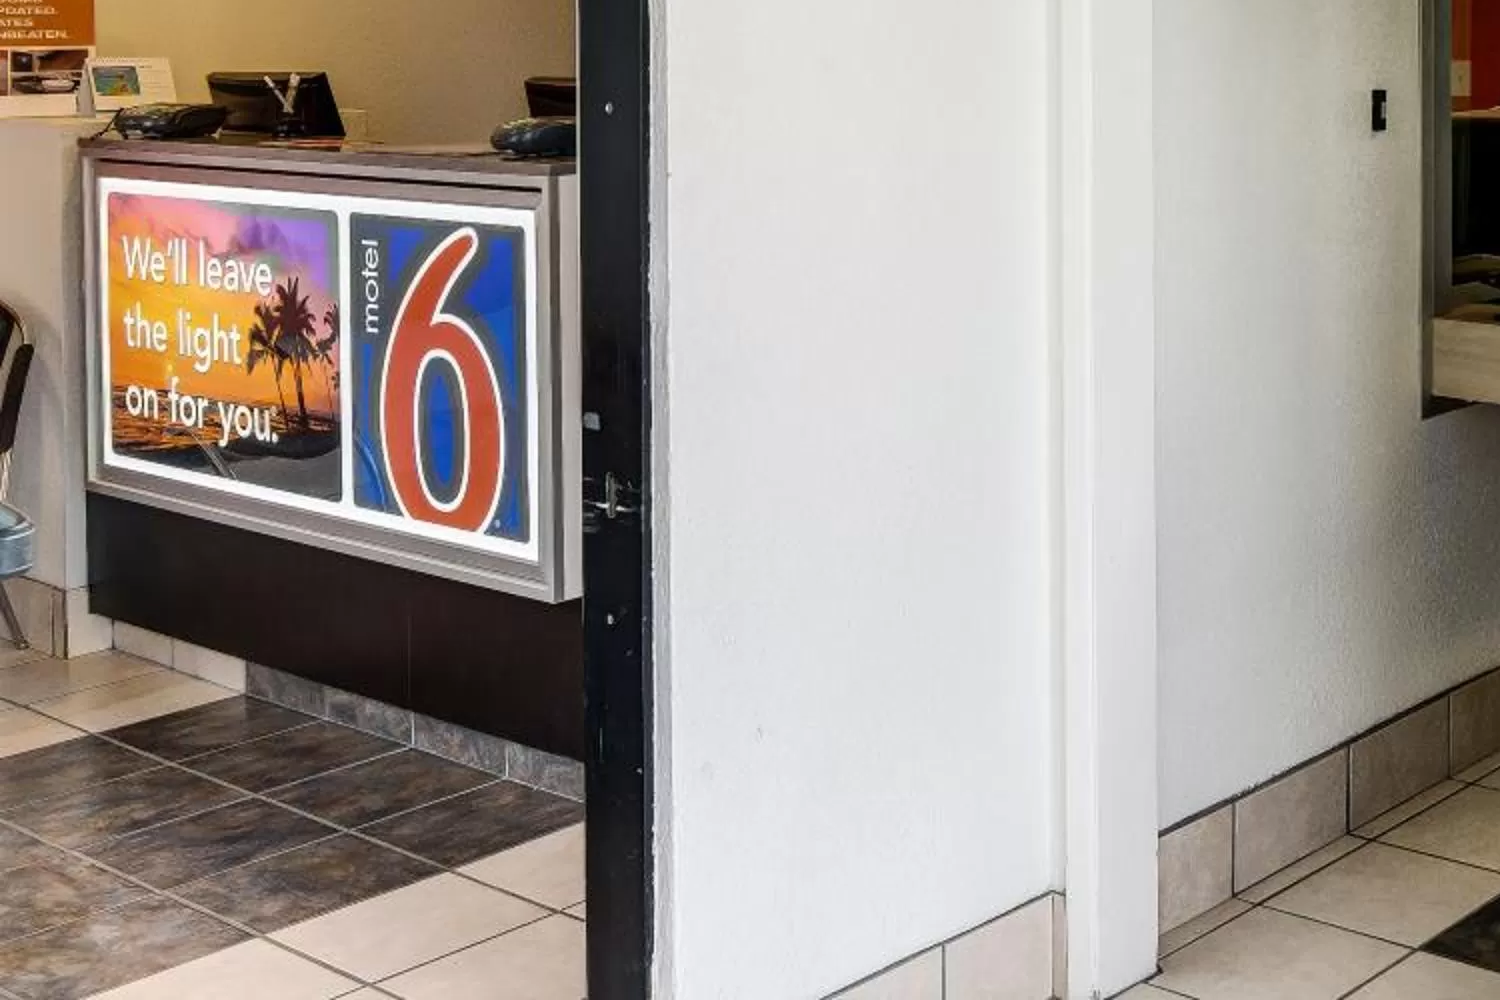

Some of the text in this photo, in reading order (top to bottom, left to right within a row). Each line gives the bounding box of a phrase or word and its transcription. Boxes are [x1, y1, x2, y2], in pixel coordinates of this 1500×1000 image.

[122, 235, 273, 297] We'll leave
[362, 238, 381, 334] motel
[123, 301, 242, 373] the light
[126, 382, 160, 418] on
[168, 376, 209, 429] for
[379, 226, 506, 534] 6
